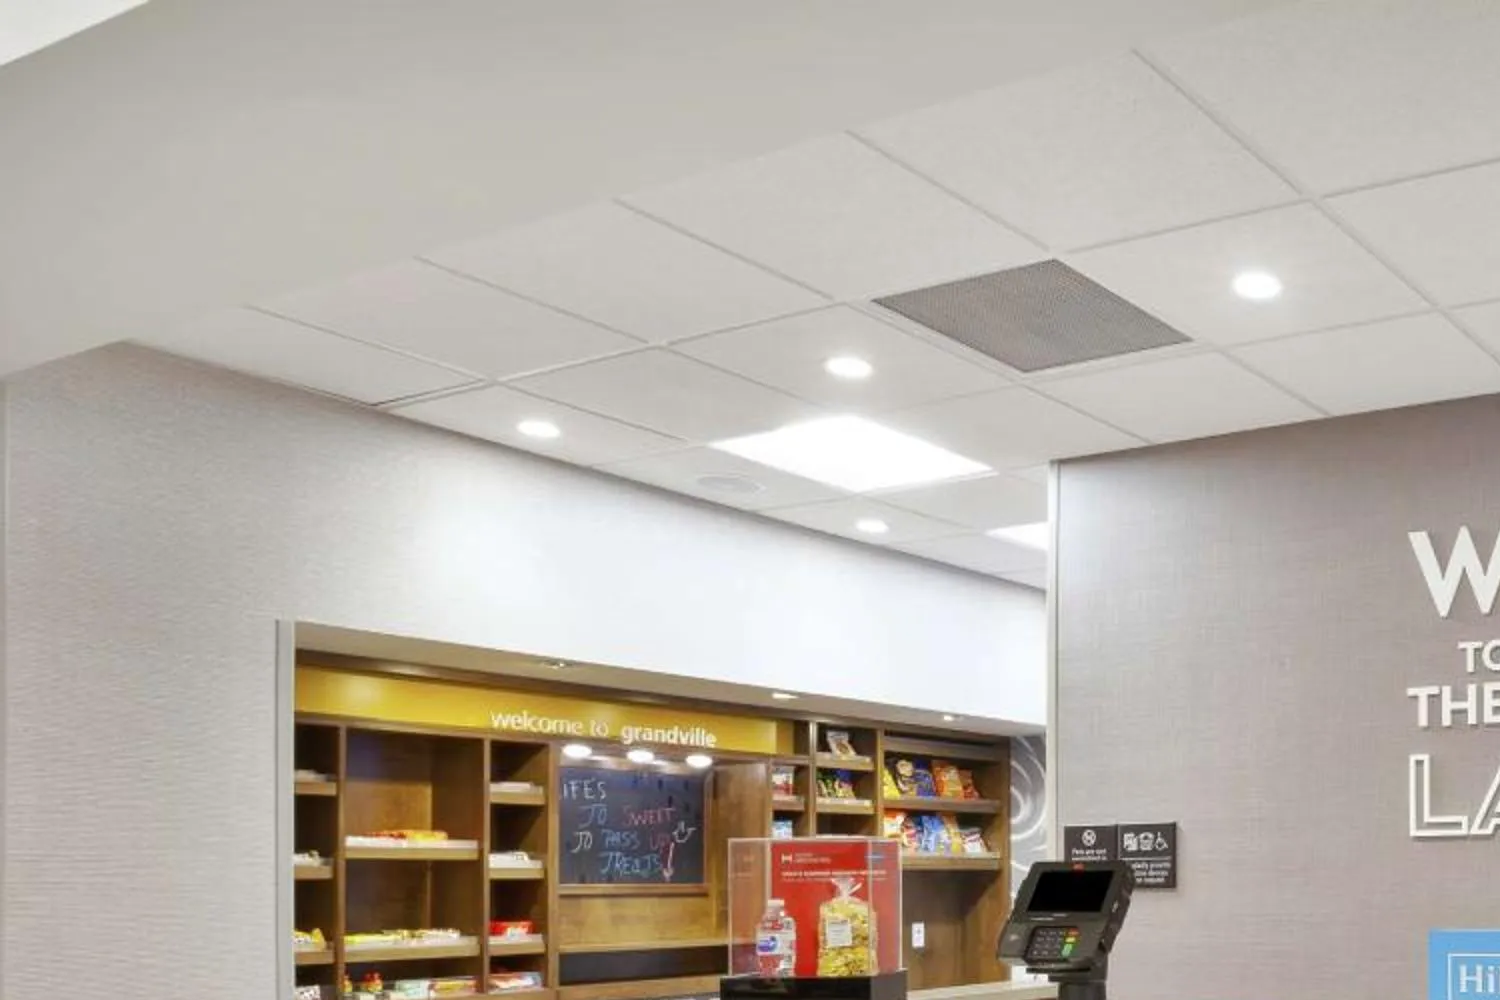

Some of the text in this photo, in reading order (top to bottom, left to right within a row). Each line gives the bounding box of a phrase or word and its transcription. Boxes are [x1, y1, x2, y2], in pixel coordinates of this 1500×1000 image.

[491, 710, 717, 748] welcome to grandville
